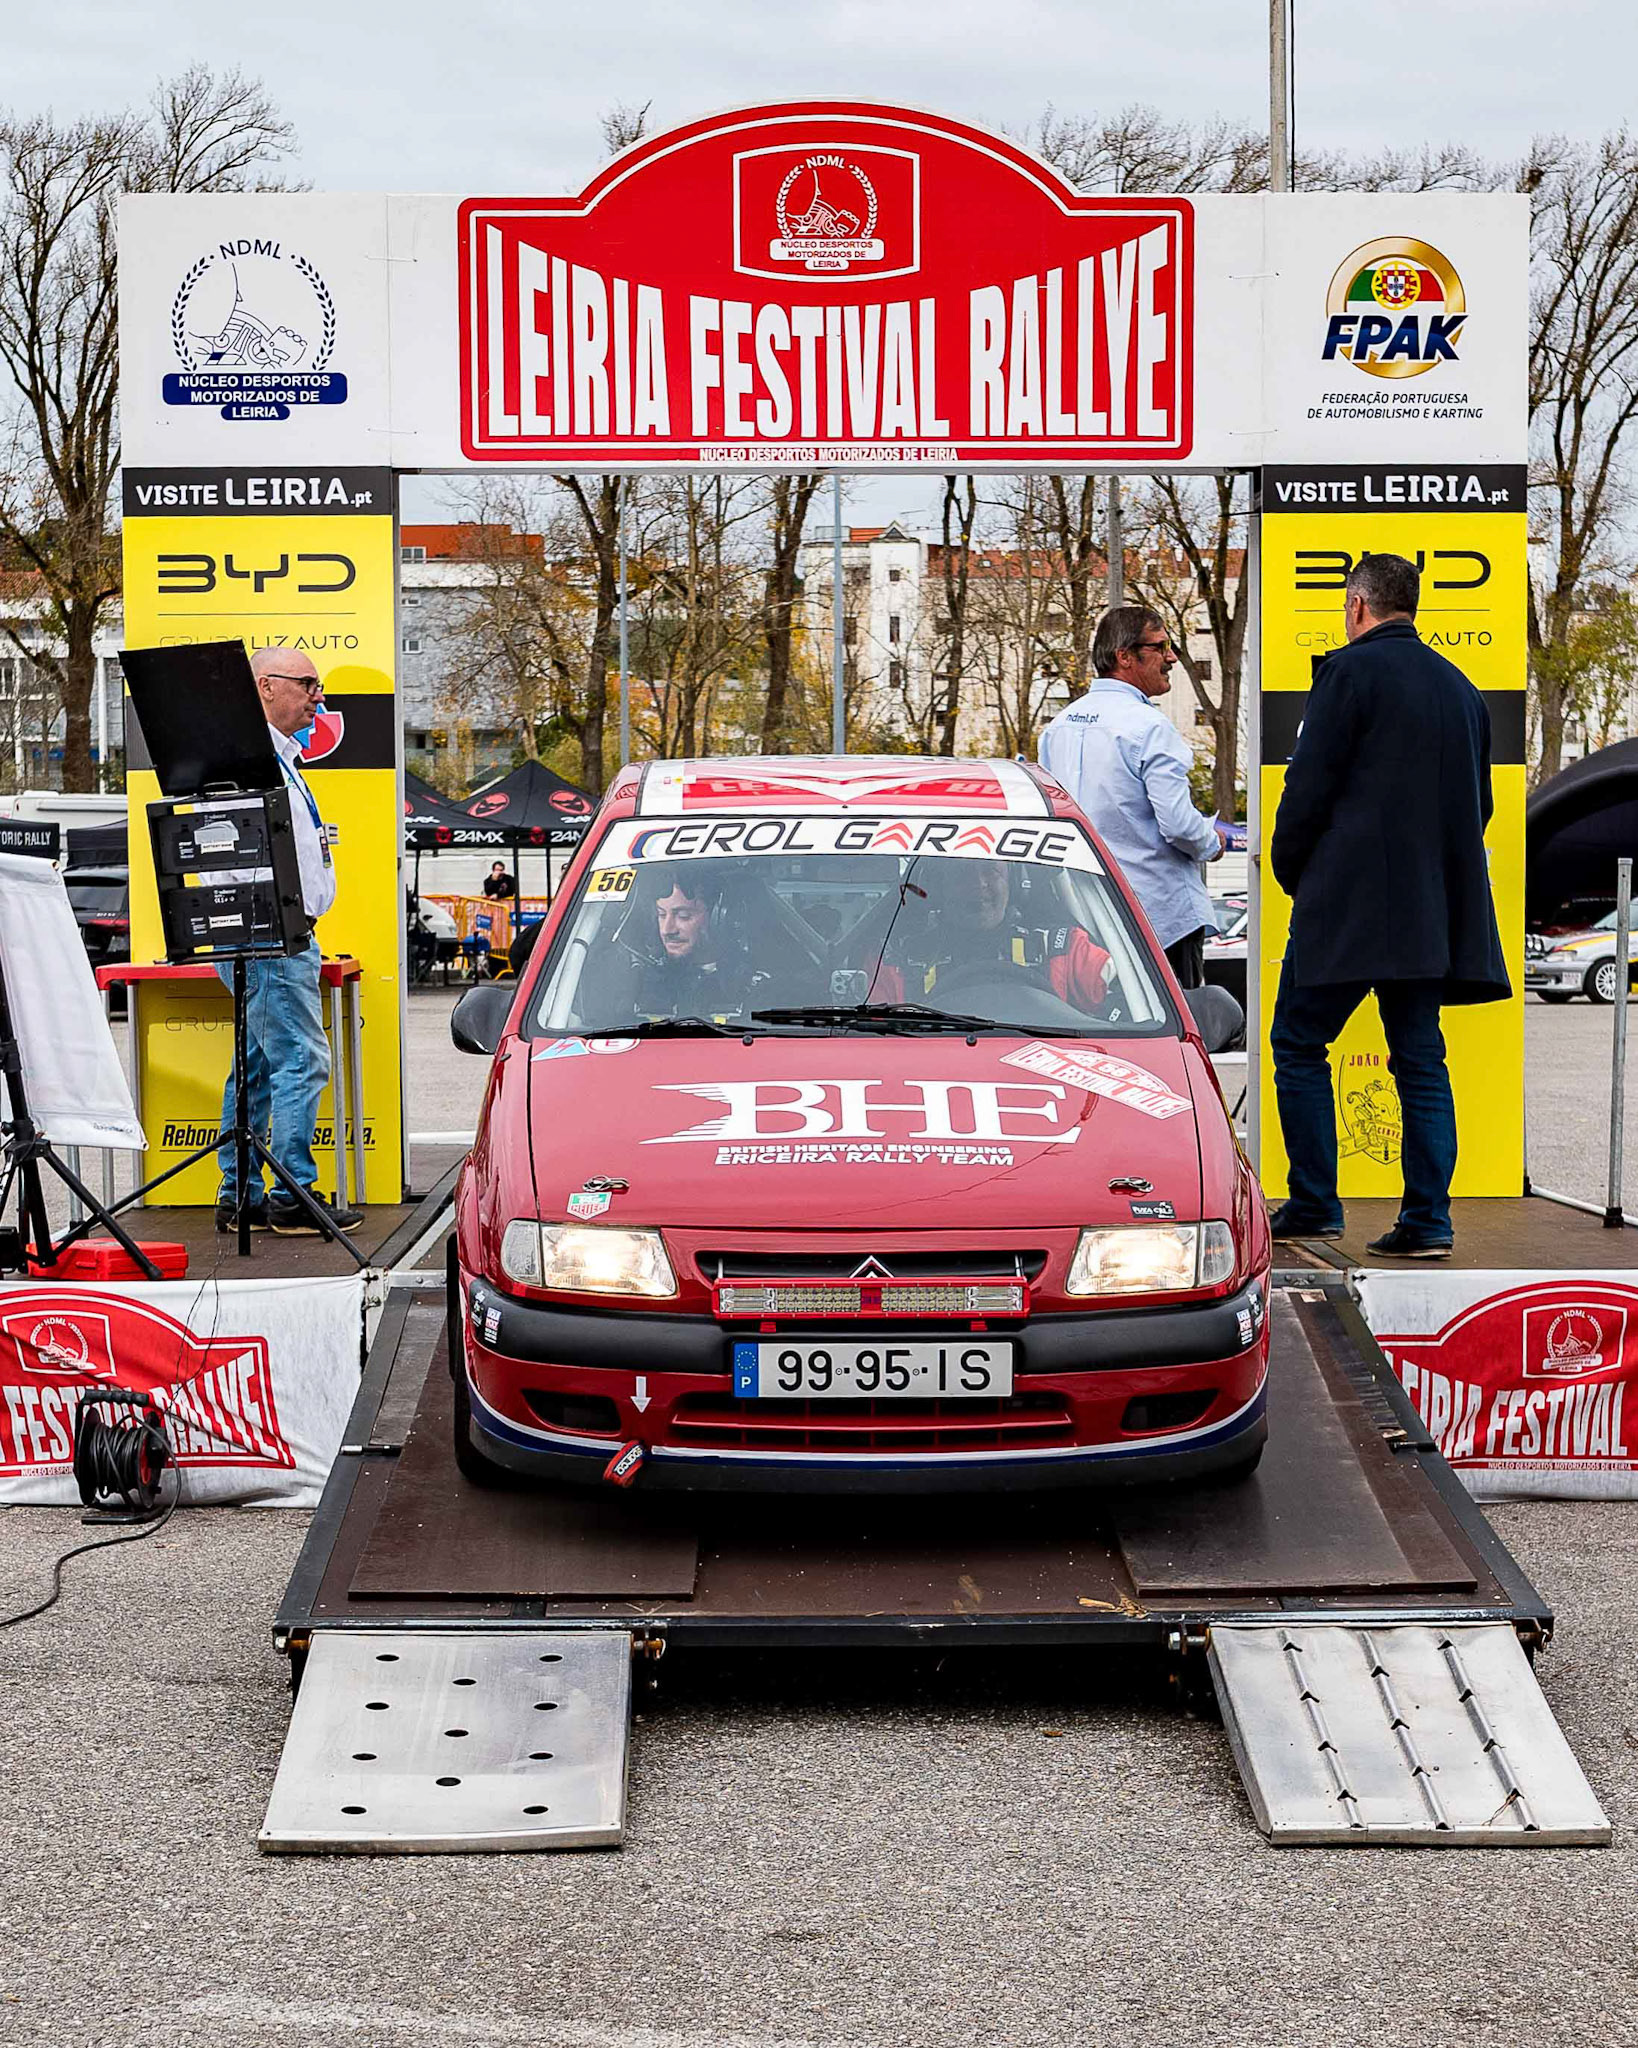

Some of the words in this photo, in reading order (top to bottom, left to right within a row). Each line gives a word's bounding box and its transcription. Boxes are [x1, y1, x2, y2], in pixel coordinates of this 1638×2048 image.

[806, 154, 845, 169] NDML
[219, 239, 282, 260] NDML
[820, 241, 873, 249] DESPORTOS
[788, 250, 852, 258] MOTORIZADOS
[854, 250, 867, 258] DE
[813, 260, 842, 268] LEIRIA
[487, 223, 671, 437] LEIRIA
[690, 295, 950, 438] FESTIVAL
[969, 222, 1170, 437] RALLYE
[1321, 315, 1469, 361] FPAK
[179, 371, 239, 388] NÚCLEO
[242, 374, 331, 387] DESPORTOS
[190, 390, 296, 403] MOTORIZADOS
[299, 390, 321, 403] DE
[1322, 391, 1389, 406] FEDERAÇÃO
[1392, 393, 1469, 405] PORTUGUESA
[232, 406, 279, 418] LEIRIA
[1307, 408, 1322, 419] DE
[1325, 408, 1420, 419] AUTOMOBILISMO
[1423, 408, 1430, 418] E
[1433, 408, 1484, 419] KARTING
[750, 448, 816, 461] DESPORTOS
[818, 448, 901, 461] MOTORIZADOS
[903, 448, 919, 461] DE
[921, 448, 959, 461] LEIRIA
[136, 484, 218, 506] VISITE
[225, 477, 373, 508] LEIRIA.pt
[1275, 481, 1357, 502] VISITE
[1363, 475, 1509, 505] LEIRIA.pt
[157, 553, 357, 593] BYD
[1295, 550, 1491, 589] BD
[1066, 712, 1100, 725] ndml.pt
[24, 831, 51, 846] RALLY
[453, 831, 505, 843] 24MX
[597, 871, 633, 891] 56
[1349, 1053, 1379, 1067] JOÃO
[640, 1080, 1081, 1143] BHE
[718, 1145, 793, 1154] BRITISH
[795, 1143, 884, 1153] HERITAGE
[887, 1143, 1011, 1155] ENGINEERING
[714, 1151, 837, 1165] ERICEIRA
[845, 1151, 931, 1164] RALLY
[936, 1152, 1014, 1166] TEAM
[741, 1377, 752, 1388] P
[149, 1349, 280, 1460] RALLYE
[1486, 1382, 1628, 1457] FESTIVAL
[1516, 1462, 1553, 1471] DESPORTOS
[1555, 1463, 1599, 1471] MOTORIZADOS
[1601, 1463, 1610, 1471] DE
[1611, 1463, 1632, 1471] LEIRIA
